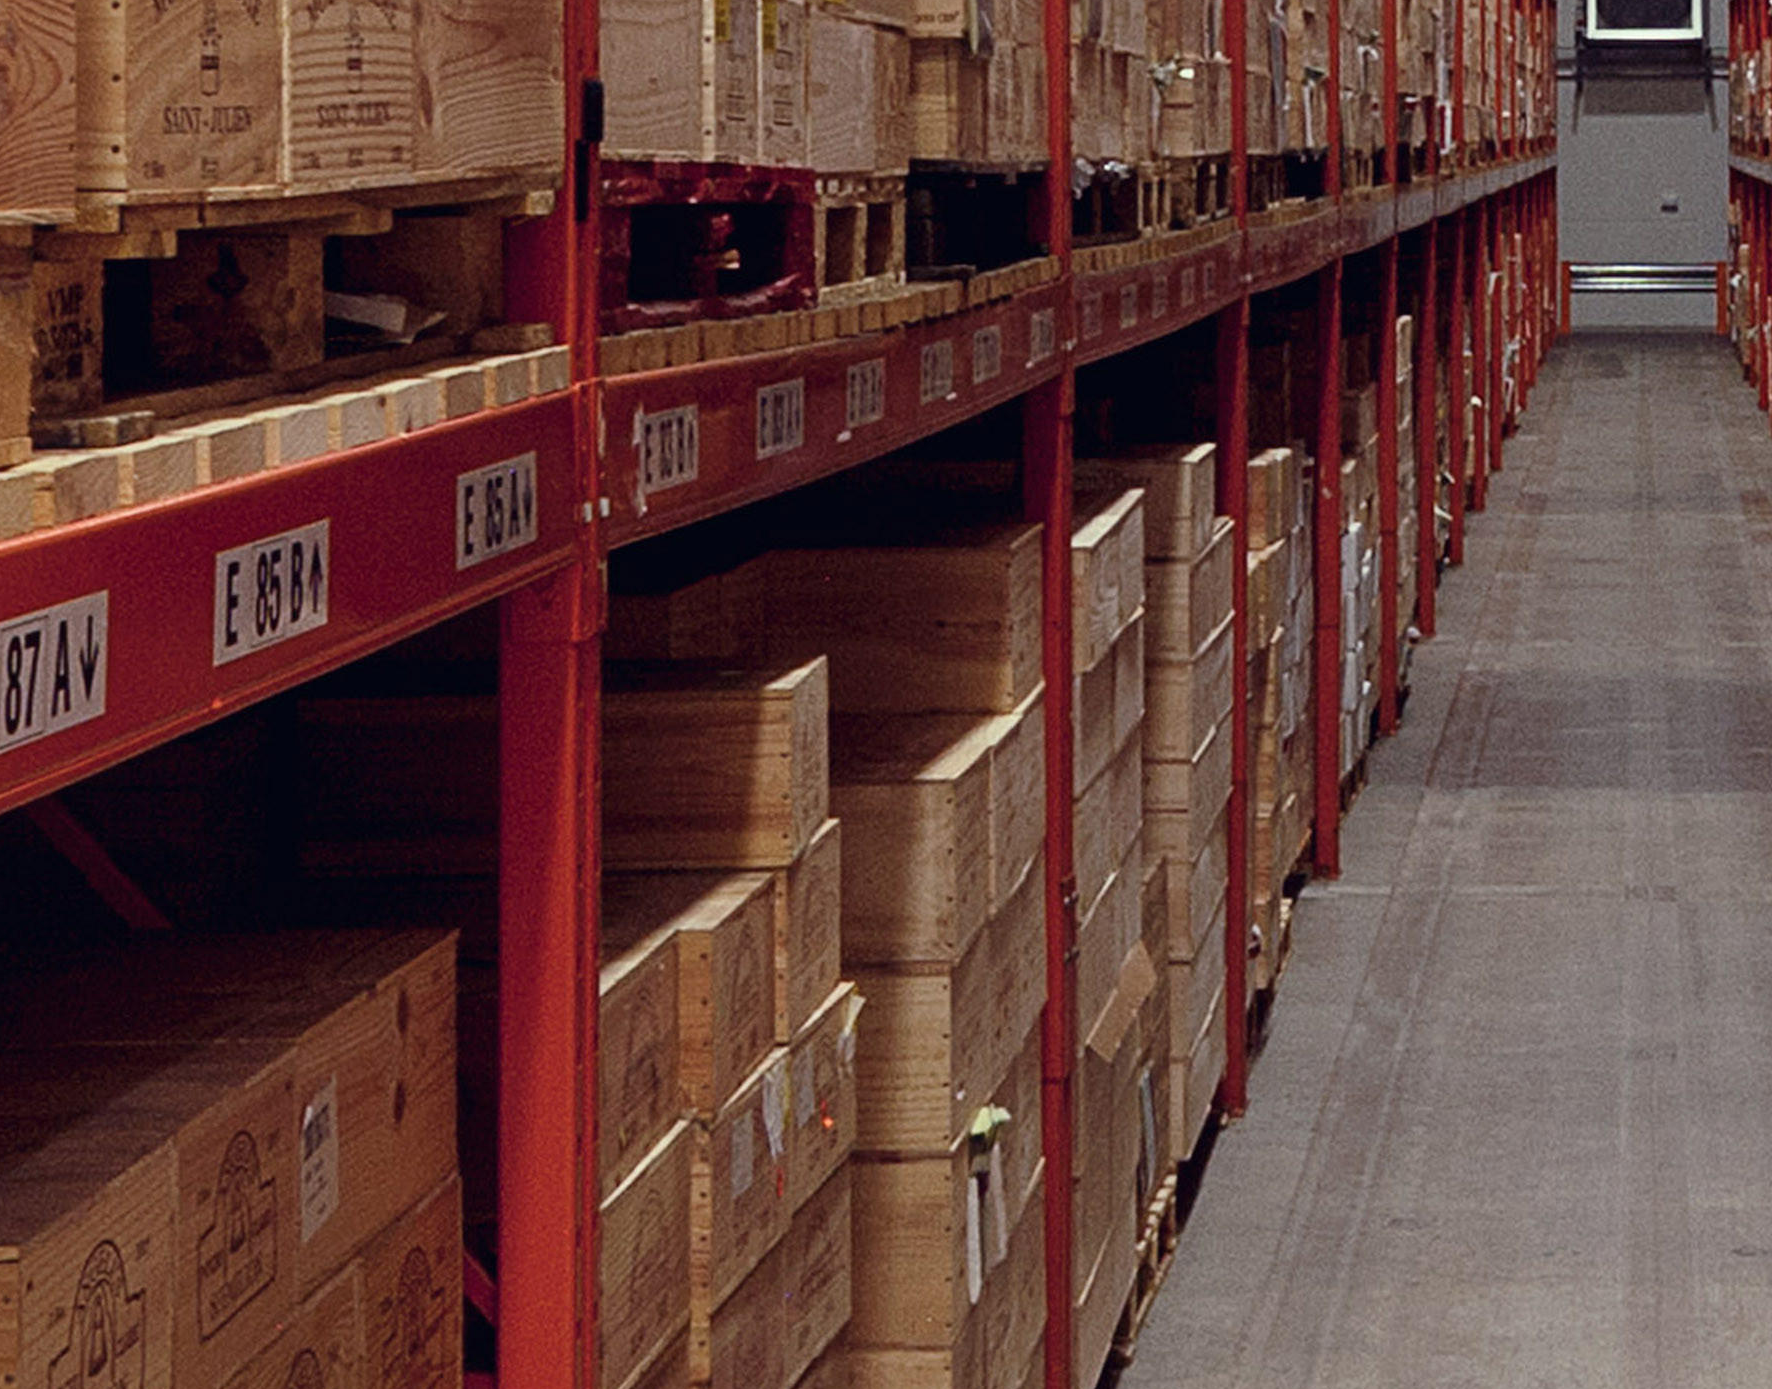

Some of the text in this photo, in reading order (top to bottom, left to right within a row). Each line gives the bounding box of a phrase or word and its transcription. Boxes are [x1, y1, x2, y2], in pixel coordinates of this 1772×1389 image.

[464, 483, 476, 557] E
[508, 469, 522, 537] A
[224, 540, 305, 649] E 85 B
[4, 629, 42, 738] 87
[50, 618, 72, 719] A
